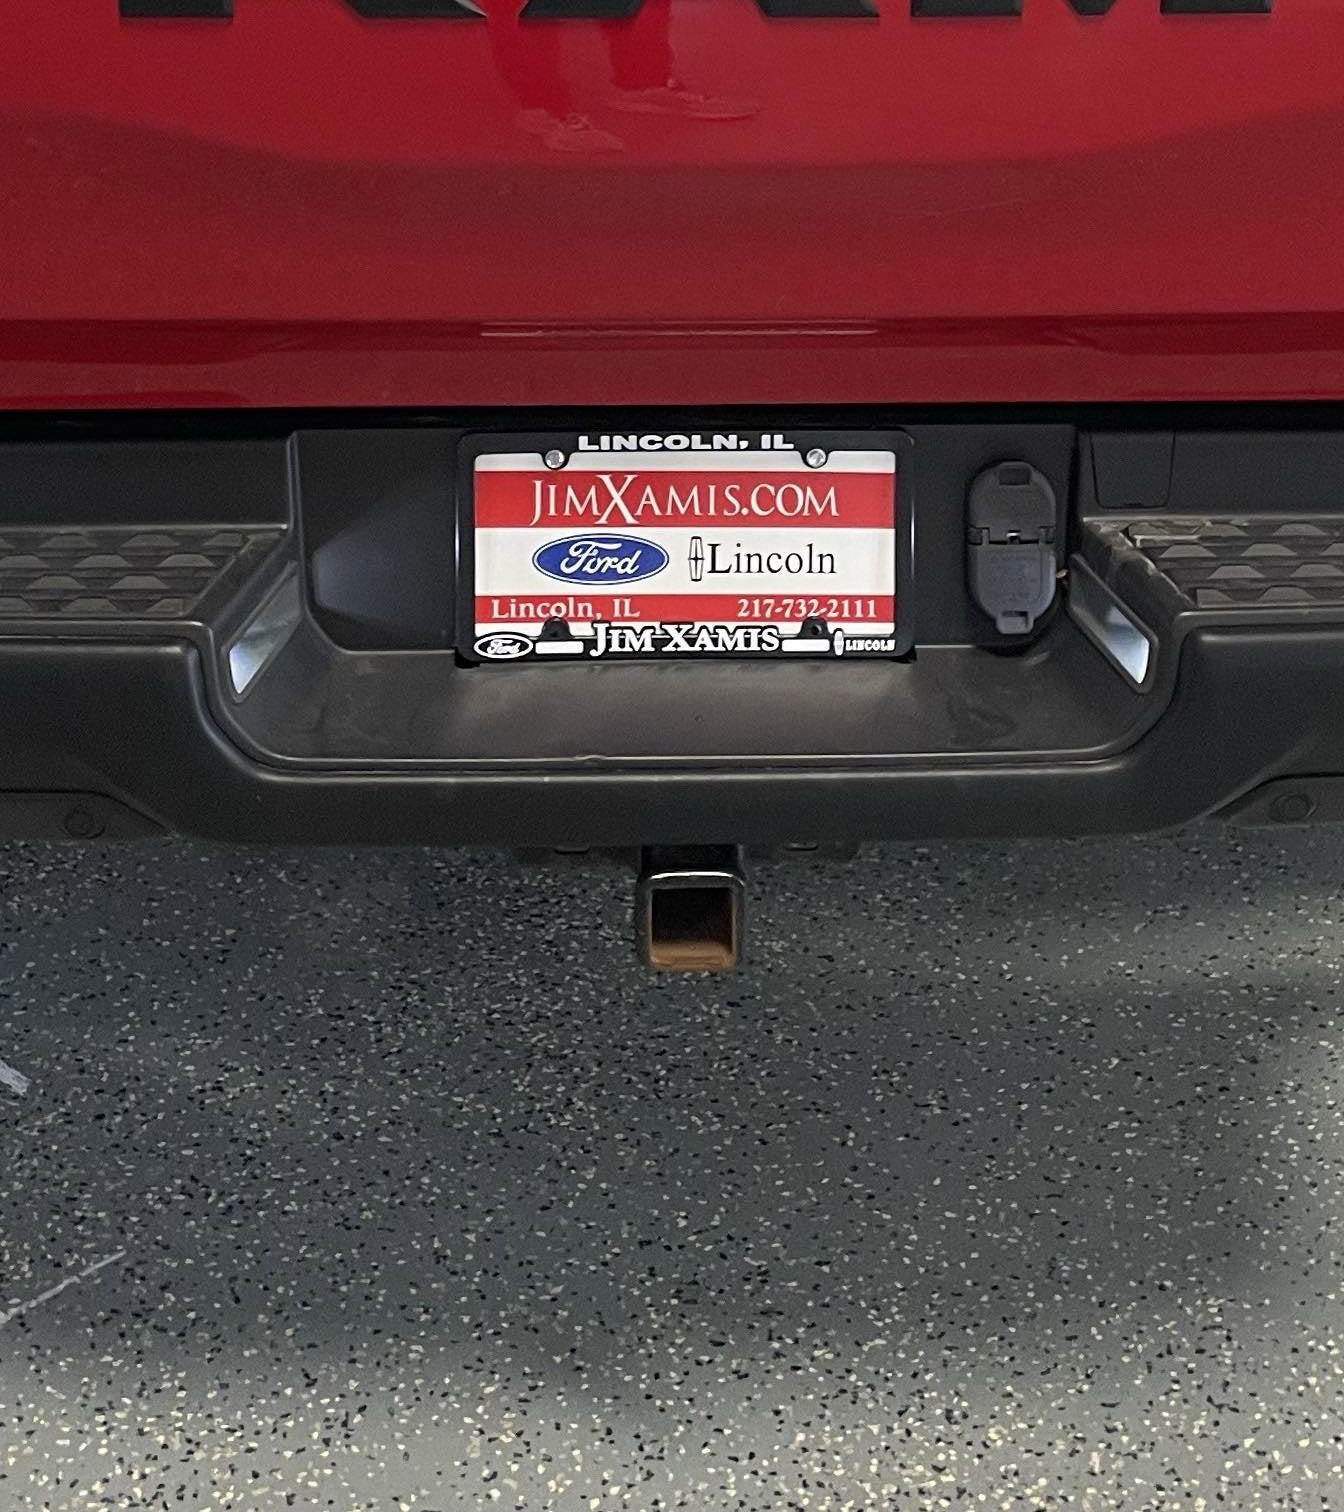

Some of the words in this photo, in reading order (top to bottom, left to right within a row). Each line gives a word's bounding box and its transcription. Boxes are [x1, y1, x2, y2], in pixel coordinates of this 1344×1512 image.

[578, 435, 749, 451] LINCOLN,
[761, 434, 795, 450] IL
[560, 541, 642, 575] Ford
[707, 543, 837, 575] Lincoln
[492, 598, 602, 620] Lincoln,
[613, 599, 640, 618] IL
[737, 599, 877, 618] 217-732-2111
[487, 639, 521, 655] Ford
[589, 623, 655, 657] JIM
[662, 626, 780, 653] XAMIS
[845, 639, 896, 652] LINCOLN
